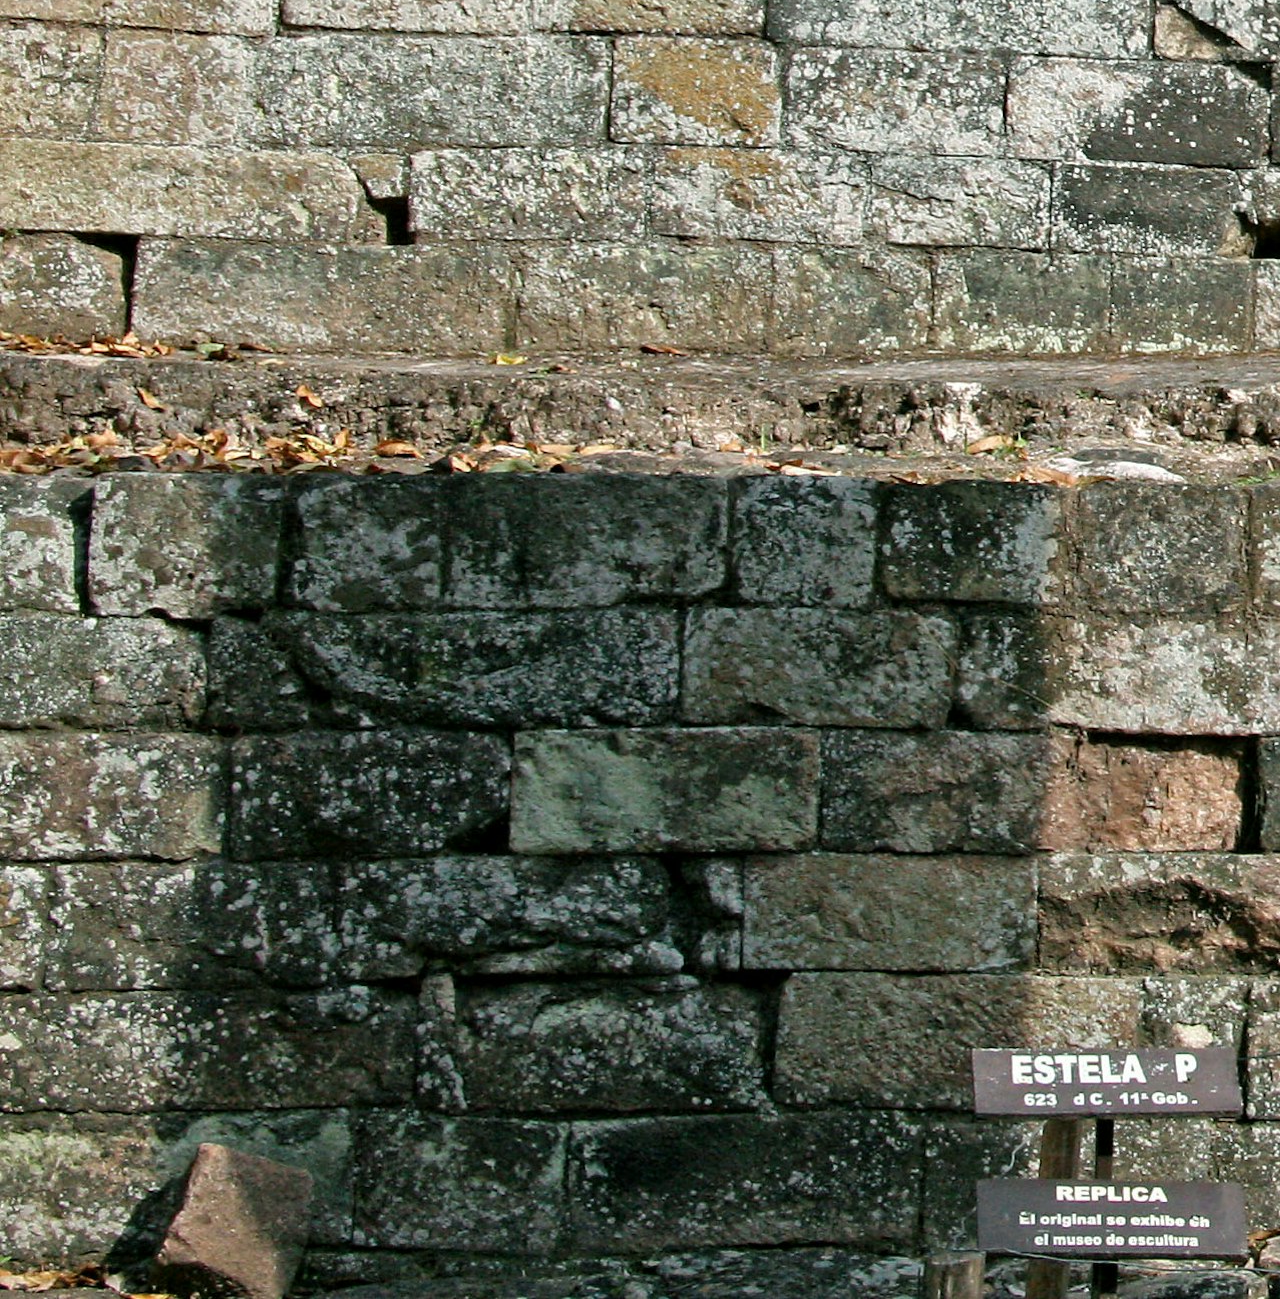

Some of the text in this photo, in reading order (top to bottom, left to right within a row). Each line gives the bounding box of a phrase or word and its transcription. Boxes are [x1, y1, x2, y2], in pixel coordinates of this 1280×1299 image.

[1011, 1053, 1197, 1084] ESTELA P
[1023, 1093, 1058, 1106] 623
[1055, 1186, 1168, 1202] REPLICA
[1039, 1213, 1102, 1228] original
[1106, 1215, 1126, 1226] se
[1130, 1214, 1185, 1227] exhibe
[1034, 1233, 1199, 1247] el museo de escultura
